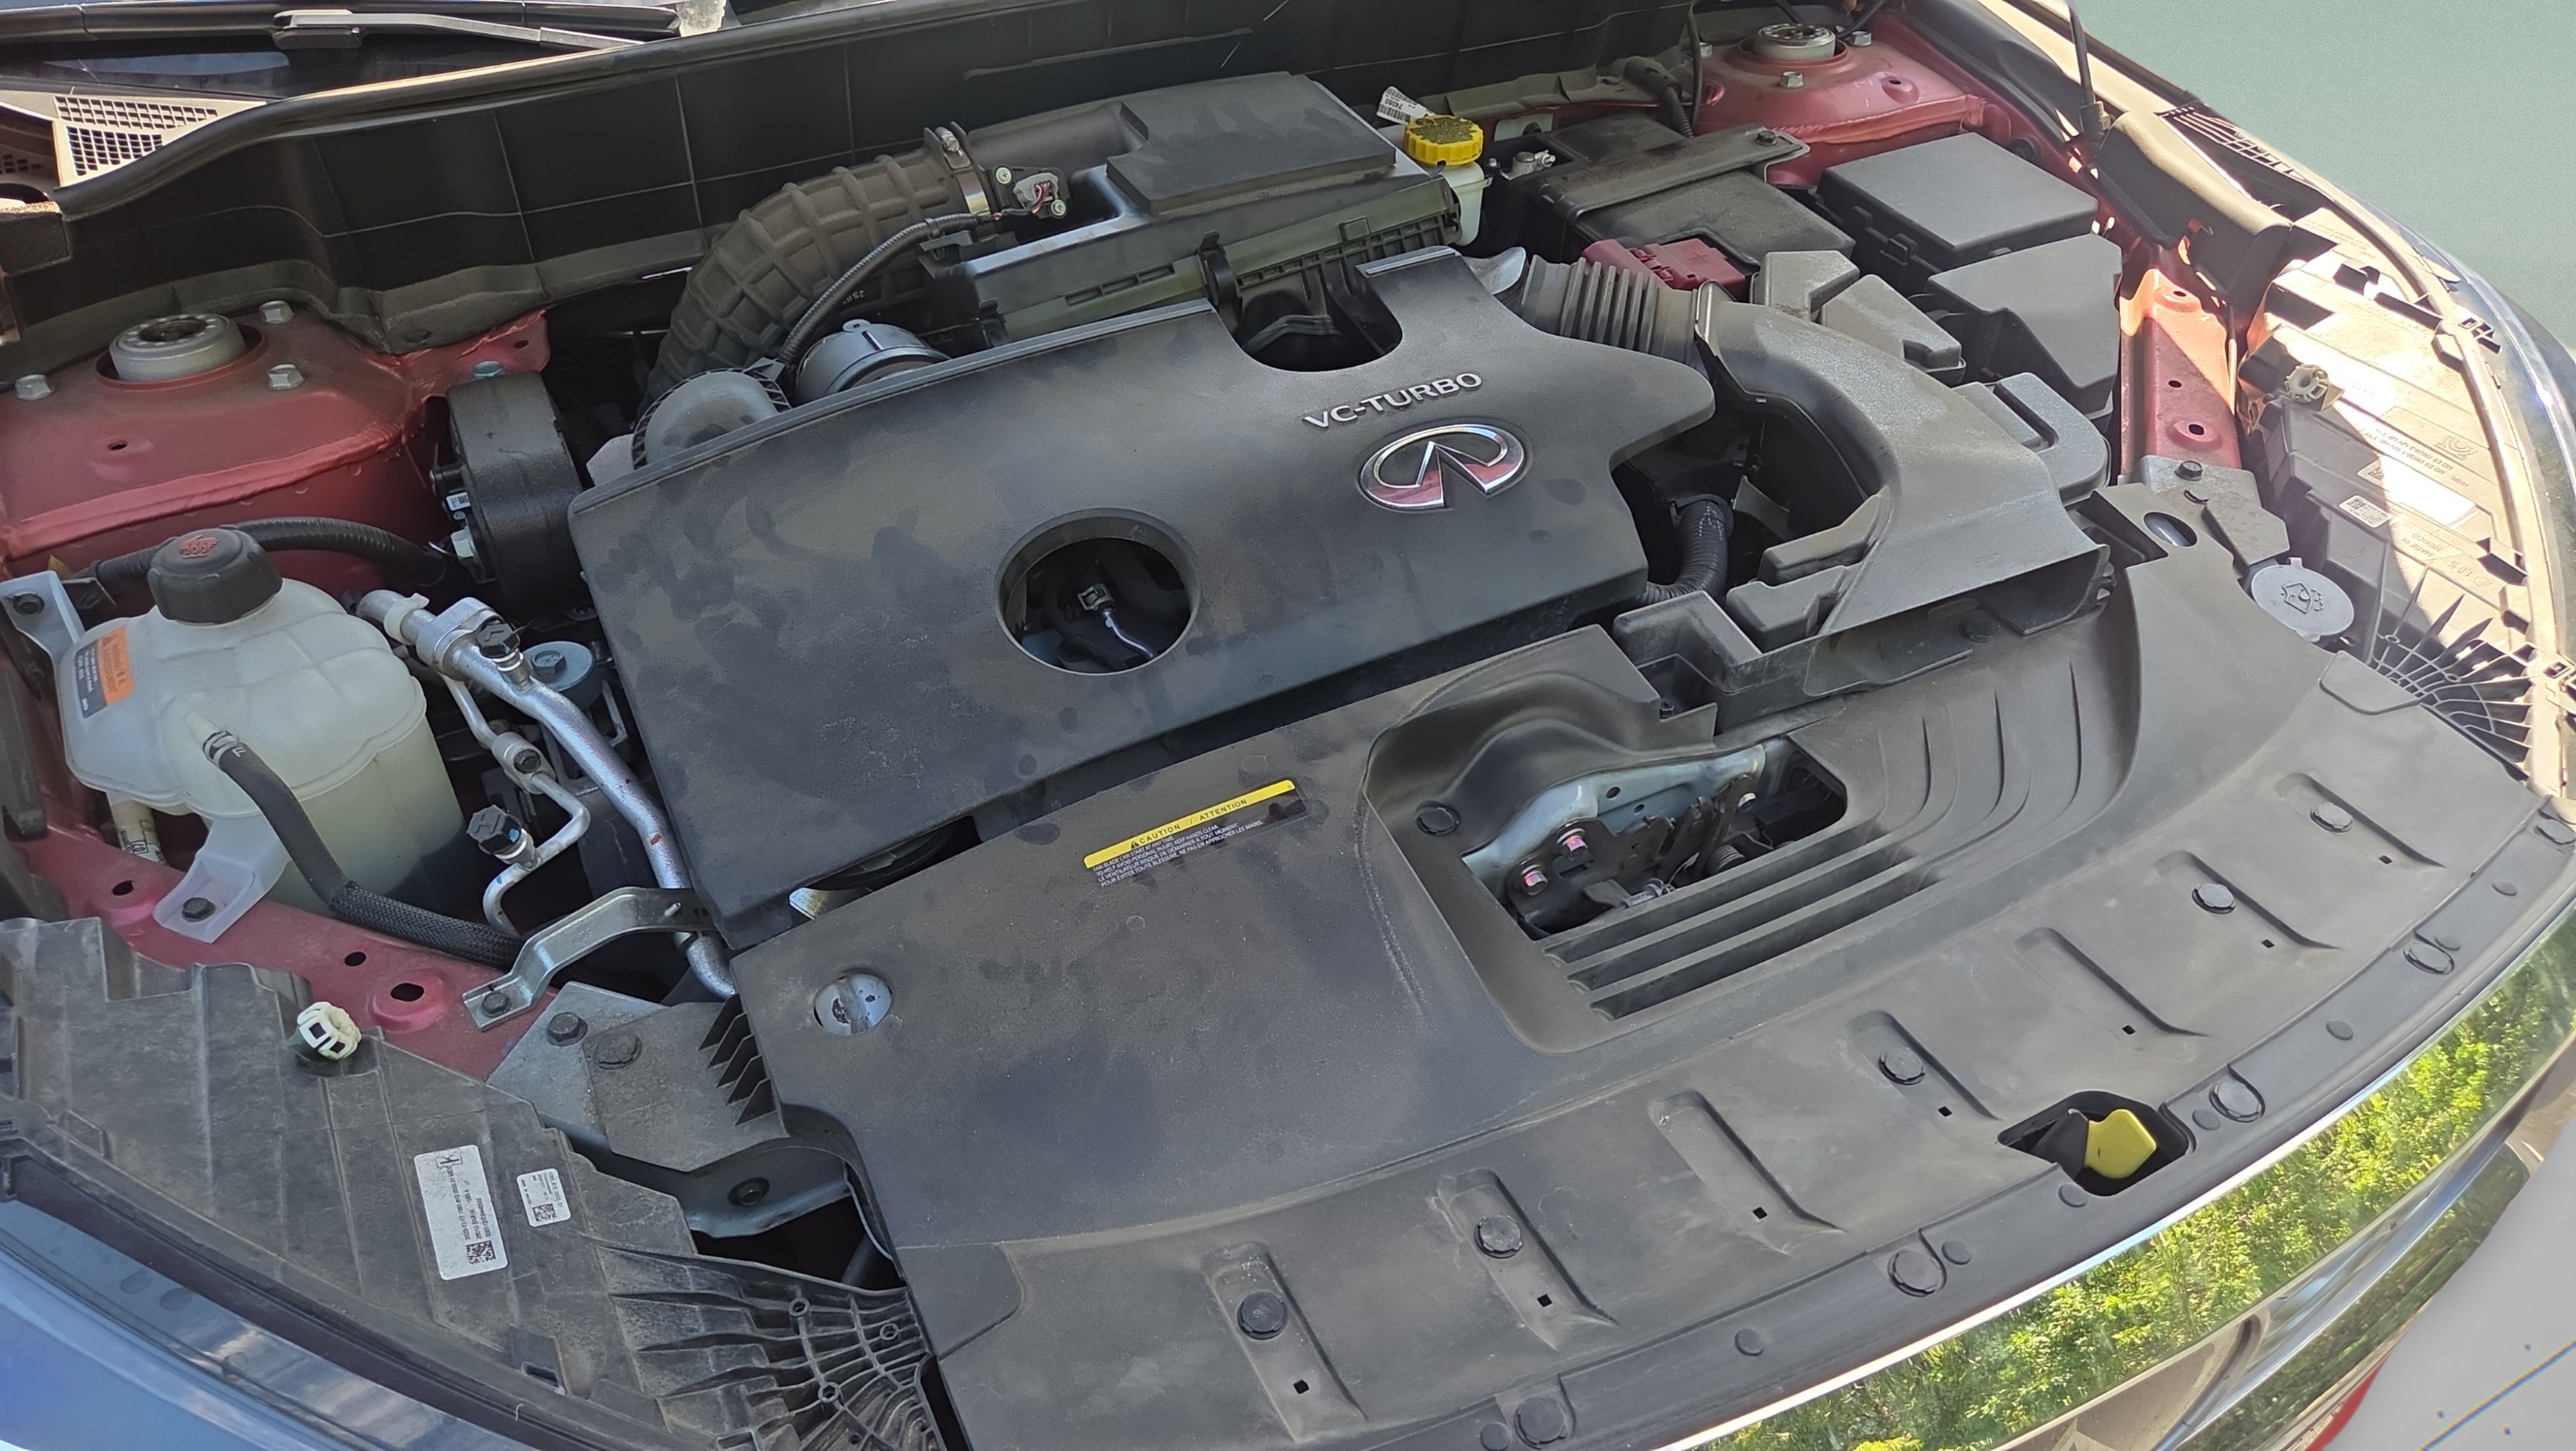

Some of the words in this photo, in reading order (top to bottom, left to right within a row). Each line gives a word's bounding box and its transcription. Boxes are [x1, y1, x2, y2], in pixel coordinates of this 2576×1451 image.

[1303, 373, 1482, 428] VC-TURBO
[1138, 823, 1181, 844] CAUTION
[1198, 798, 1247, 821] ATTENTION
[1093, 864, 1103, 872] FAN
[1103, 857, 1119, 867] BLADE
[1118, 852, 1130, 861] CAN
[1130, 846, 1144, 856] START
[1150, 839, 1163, 848] ANY
[1100, 877, 1117, 887] POUR
[1134, 861, 1153, 873] TOUTE
[1186, 844, 1197, 852] PAS
[1204, 830, 1236, 845] APPROCHER
[1234, 826, 1245, 834] LES
[1103, 865, 1116, 873] HELP
[1115, 858, 1132, 868] AVOID
[1131, 848, 1157, 862] PERSONAL
[1173, 836, 1186, 844] KEEP
[1185, 830, 1203, 840] HANDS
[1104, 861, 1140, 879] VENTILATEUR
[1139, 853, 1159, 865] RISQUE
[1200, 831, 1214, 840] TOUT
